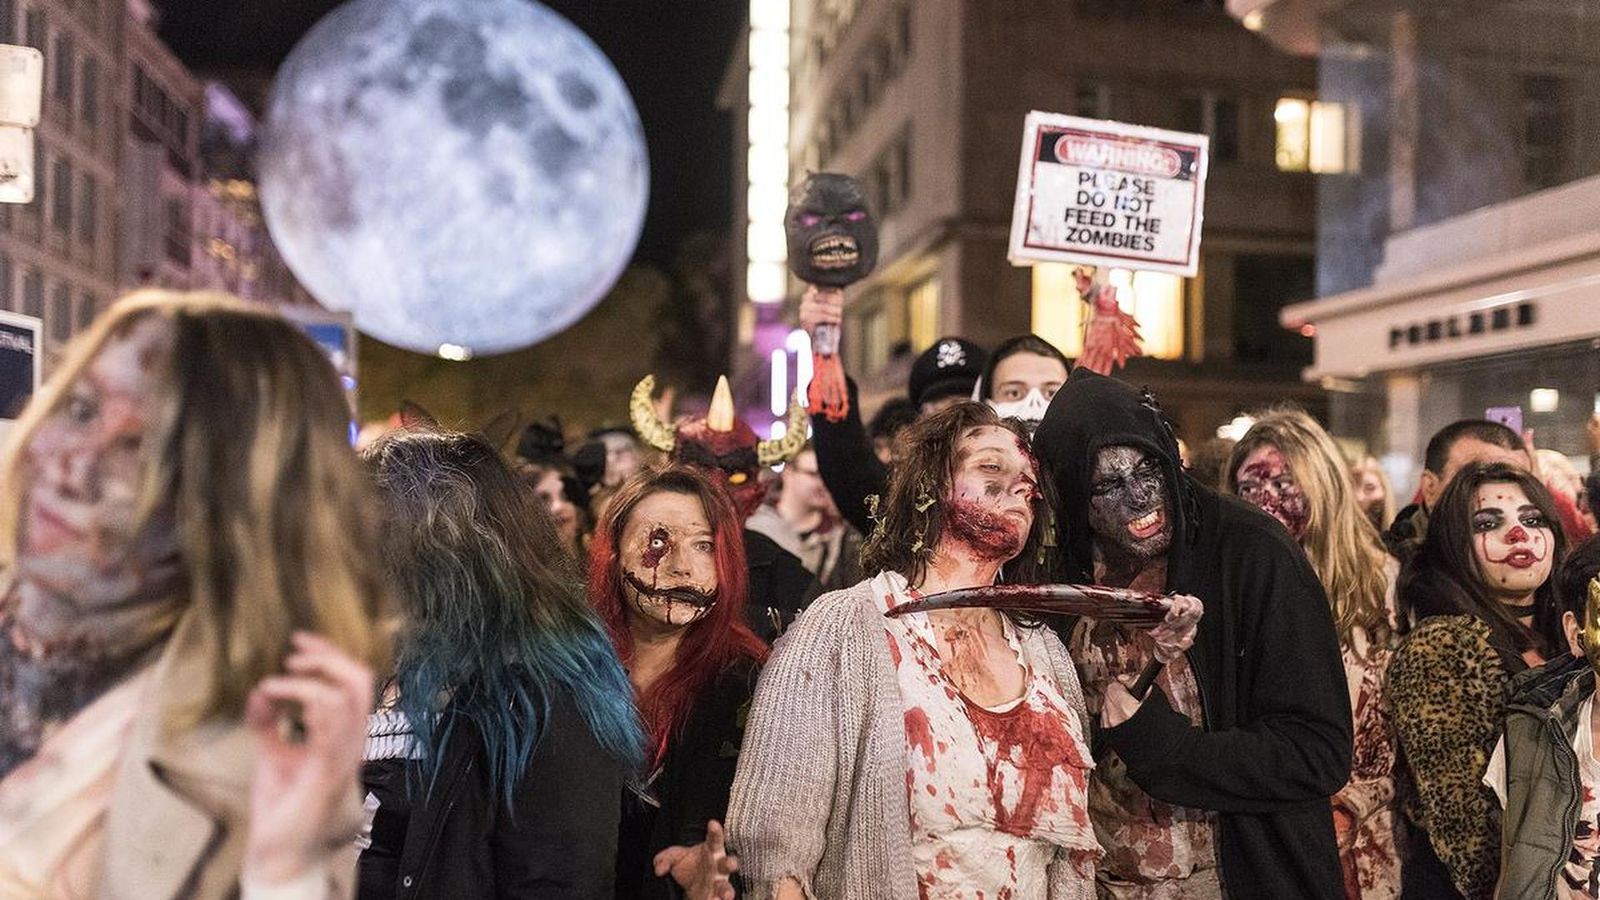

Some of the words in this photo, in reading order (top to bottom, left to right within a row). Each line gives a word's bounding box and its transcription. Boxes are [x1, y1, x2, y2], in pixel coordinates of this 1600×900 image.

[1077, 190, 1106, 207] DO
[1064, 208, 1116, 229] FEED
[1124, 215, 1161, 234] THE
[1065, 226, 1155, 252] ZOMBIES
